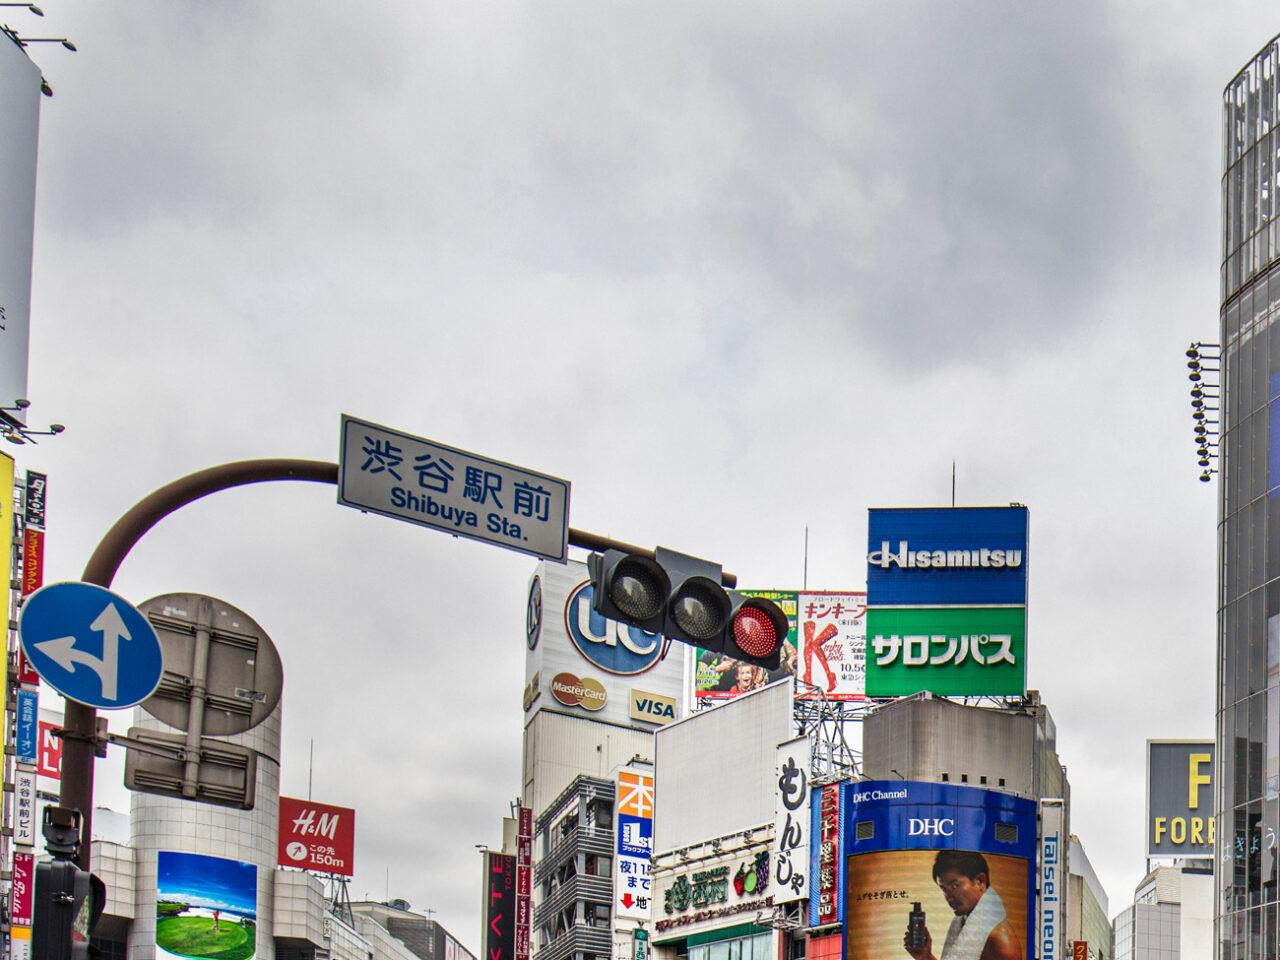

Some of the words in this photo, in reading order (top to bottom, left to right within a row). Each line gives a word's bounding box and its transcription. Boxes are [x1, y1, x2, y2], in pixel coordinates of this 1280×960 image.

[360, 435, 552, 523] 渋谷駅前
[390, 486, 478, 527] Shibuya
[486, 513, 529, 541] Sta.
[867, 540, 1022, 568] Hisamitsu
[871, 634, 1016, 666] サロンパス
[551, 681, 606, 702] MasterCard
[635, 697, 675, 719] VISA
[18, 777, 32, 839] 渋谷駅前ビル
[853, 792, 871, 804] DHC
[871, 788, 908, 801] Channel
[292, 808, 340, 841] H&M
[775, 755, 810, 897] もんじゃ
[908, 818, 955, 837] DHC
[309, 843, 336, 856] この先
[309, 852, 345, 868] 150m
[1043, 830, 1059, 902] Taisei
